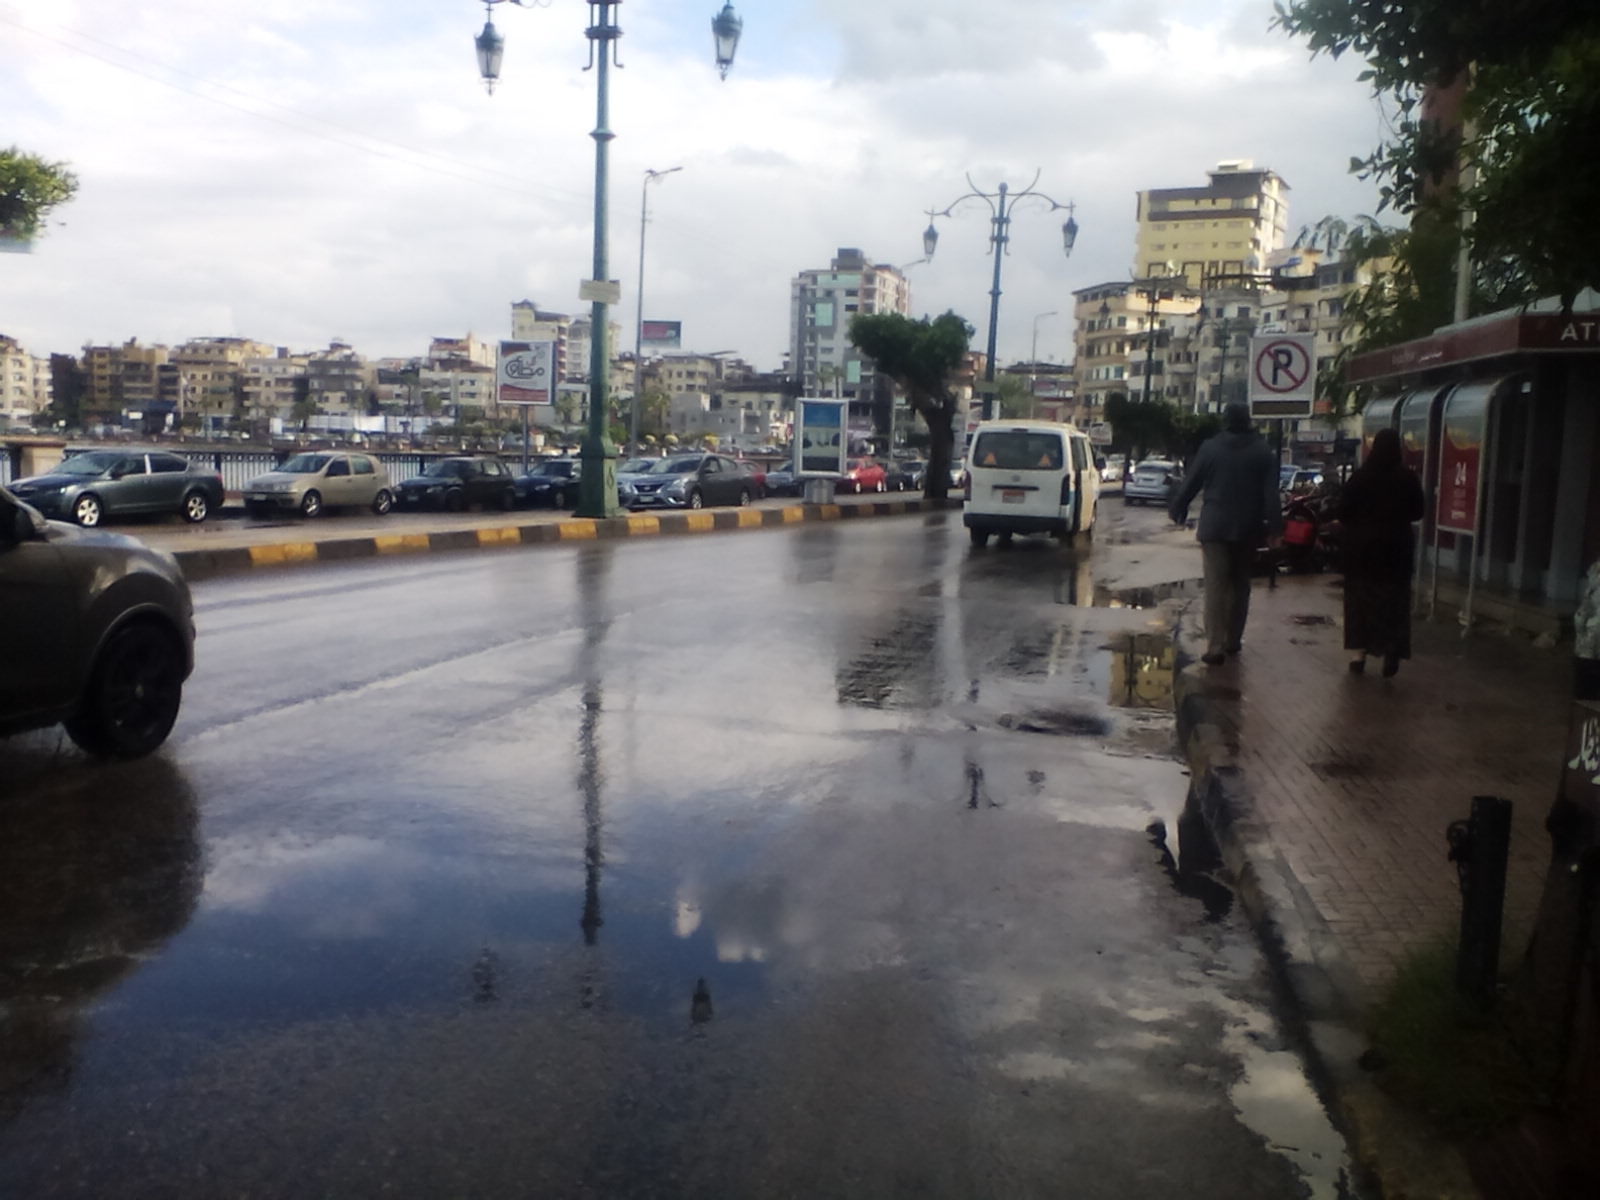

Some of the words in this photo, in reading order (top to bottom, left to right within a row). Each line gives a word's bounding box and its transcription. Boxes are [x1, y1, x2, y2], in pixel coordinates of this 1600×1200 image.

[1560, 321, 1600, 341] AT
[1271, 347, 1293, 385] P
[1454, 461, 1467, 486] 24
